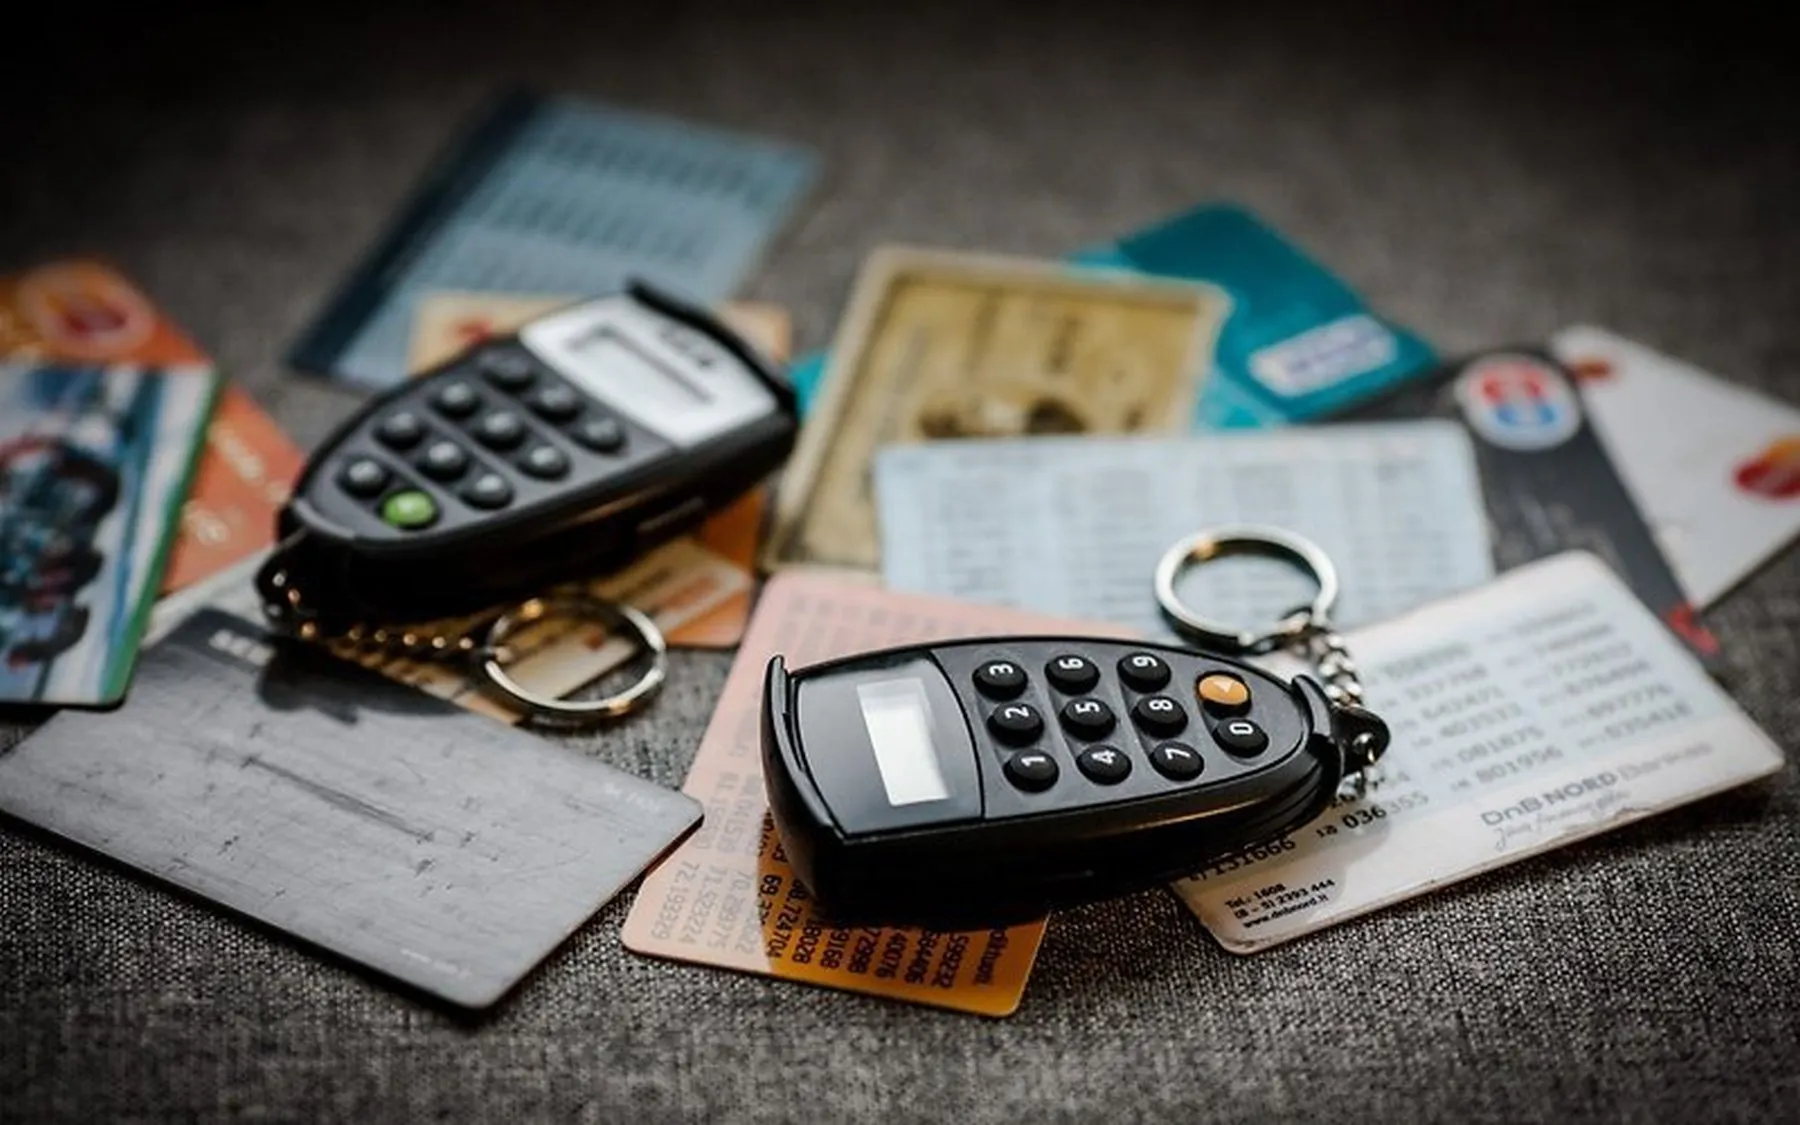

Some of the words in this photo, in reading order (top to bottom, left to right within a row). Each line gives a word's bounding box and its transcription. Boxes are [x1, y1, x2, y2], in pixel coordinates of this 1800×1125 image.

[1058, 657, 1085, 670] 6
[1132, 655, 1159, 668] 9
[988, 663, 1014, 675] 3
[1004, 705, 1030, 720] 2
[1074, 701, 1101, 715] 5
[1149, 699, 1174, 712] 8
[1229, 722, 1255, 735] 0
[1091, 750, 1118, 765] 4
[1165, 747, 1191, 761] 7
[1020, 755, 1046, 768] 1
[1543, 770, 1618, 806] NORD
[792, 920, 823, 965] 8028
[875, 930, 908, 980] 40076
